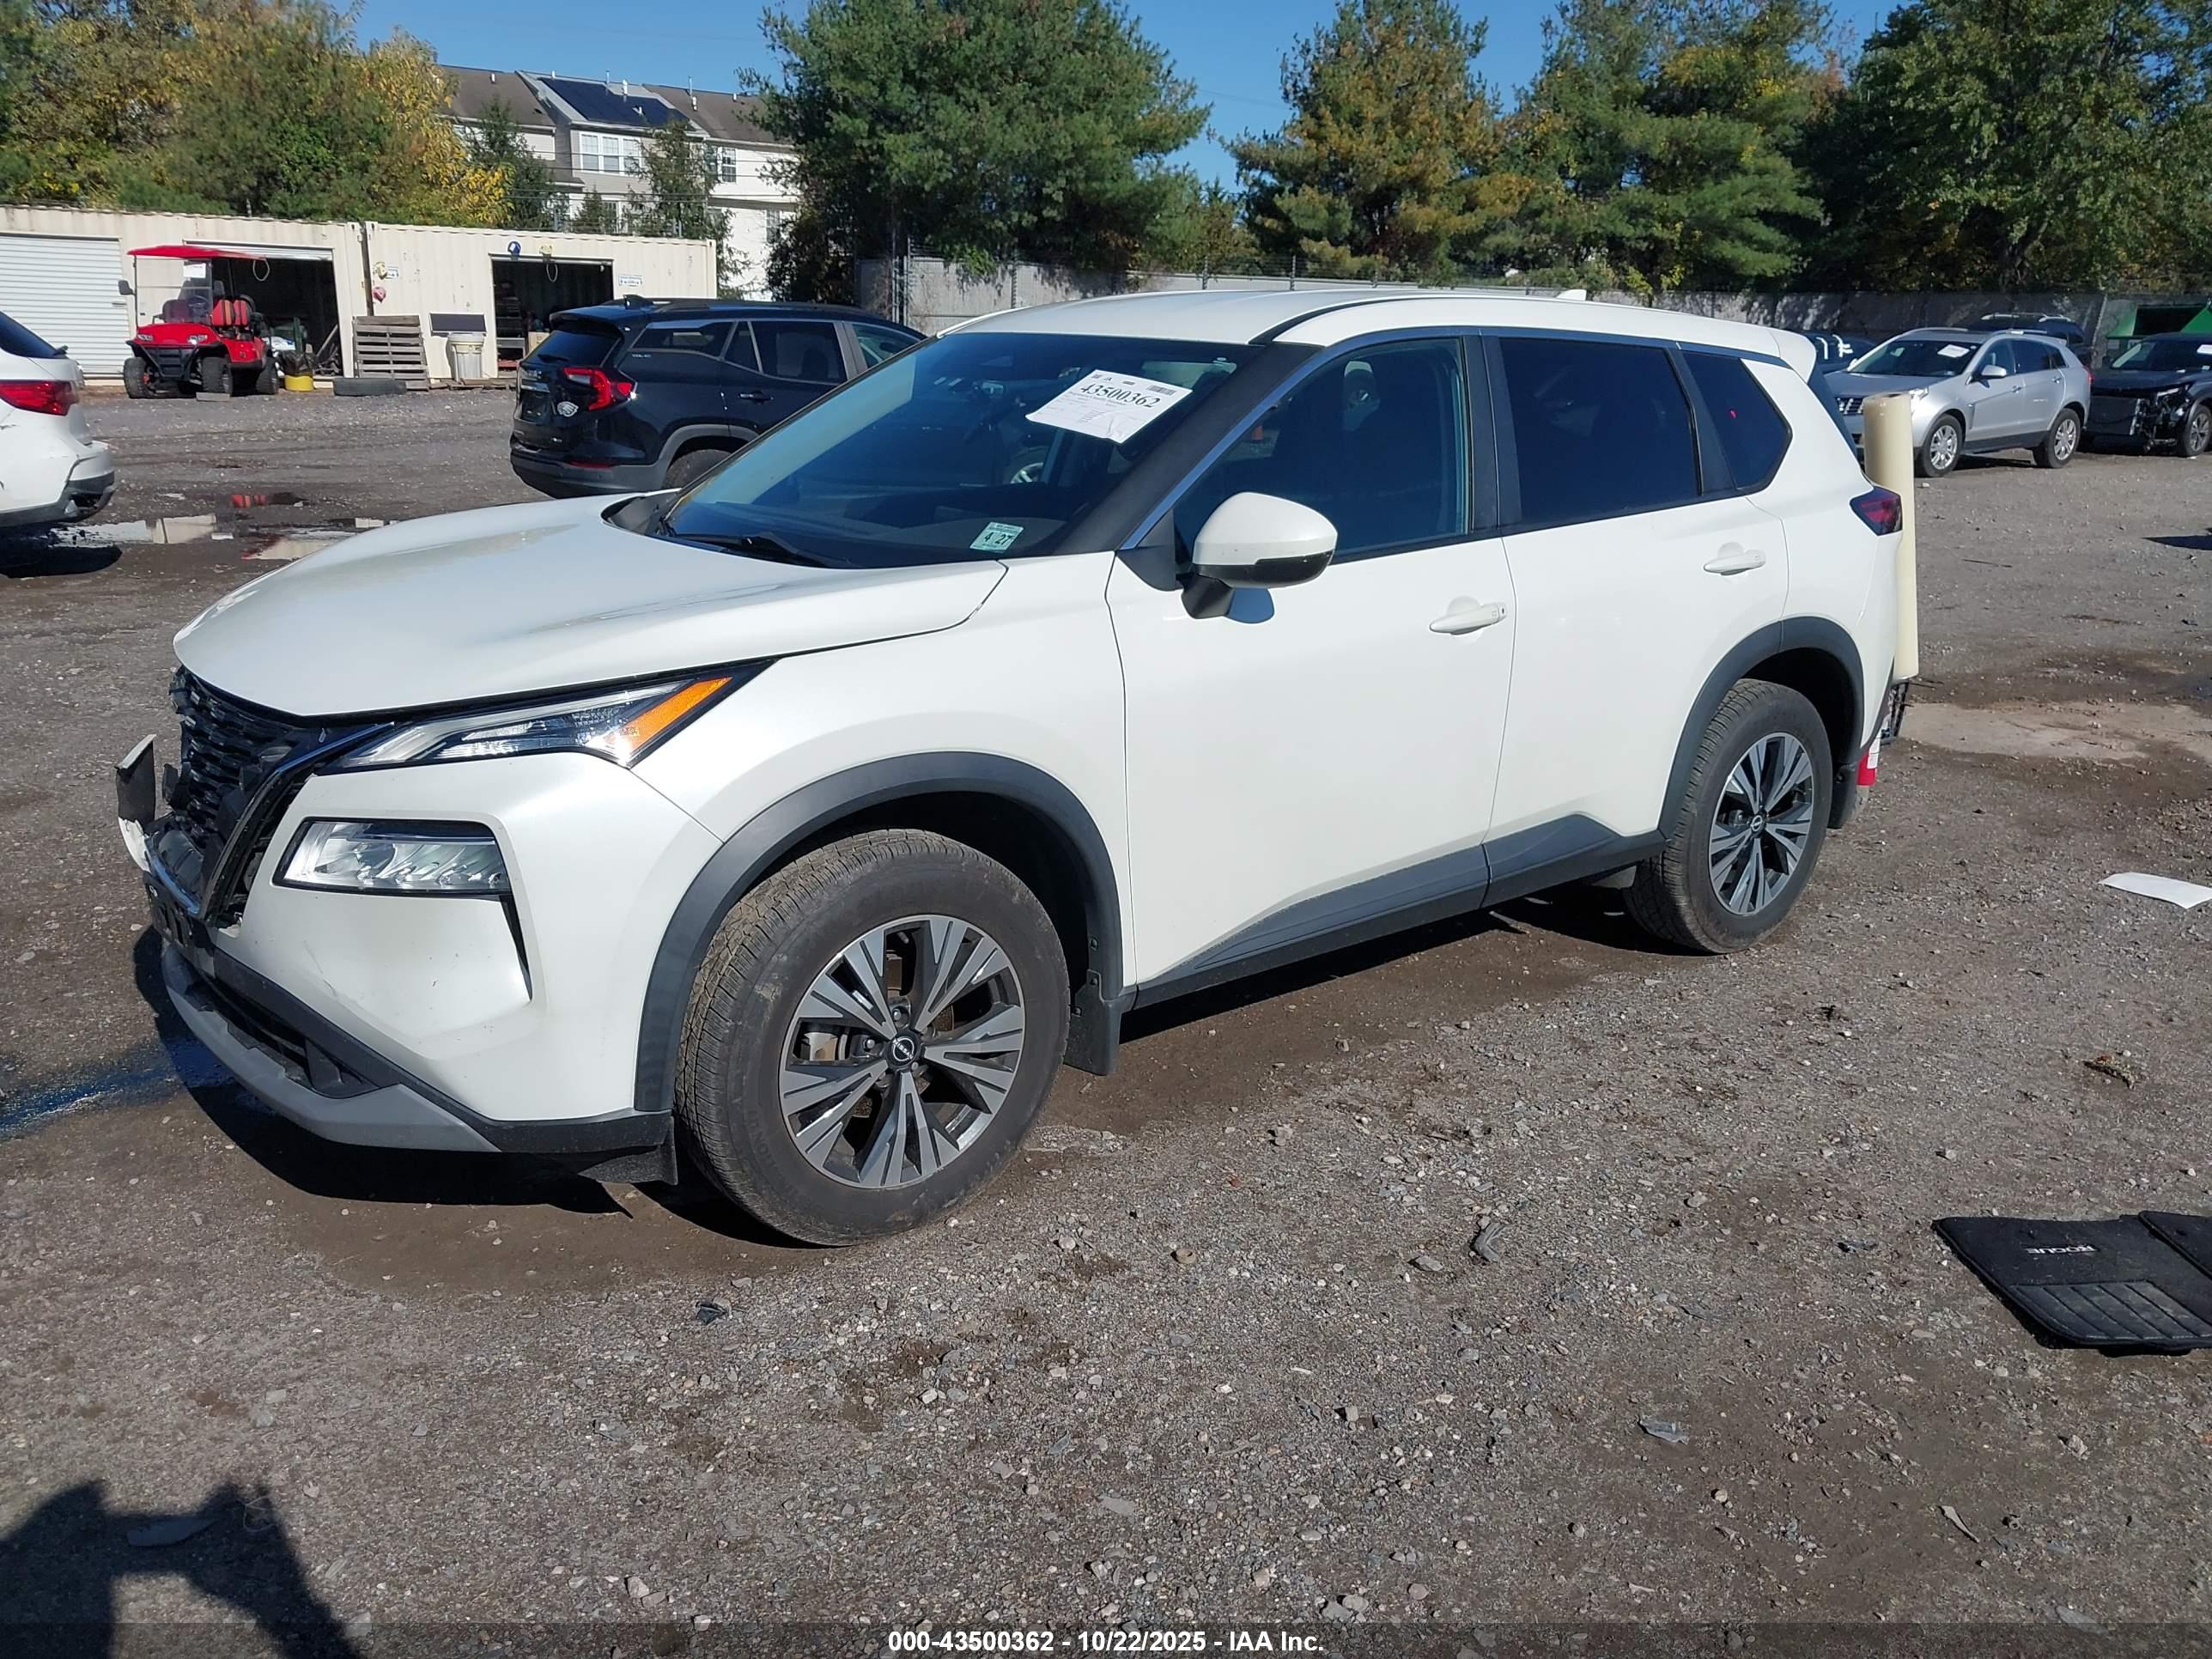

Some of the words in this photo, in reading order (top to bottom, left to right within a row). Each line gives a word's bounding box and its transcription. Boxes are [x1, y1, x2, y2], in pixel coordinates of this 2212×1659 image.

[1080, 383, 1162, 409] 43500362
[984, 532, 994, 543] 4
[994, 533, 1015, 545] 27
[2025, 1245, 2097, 1255] ROGUE
